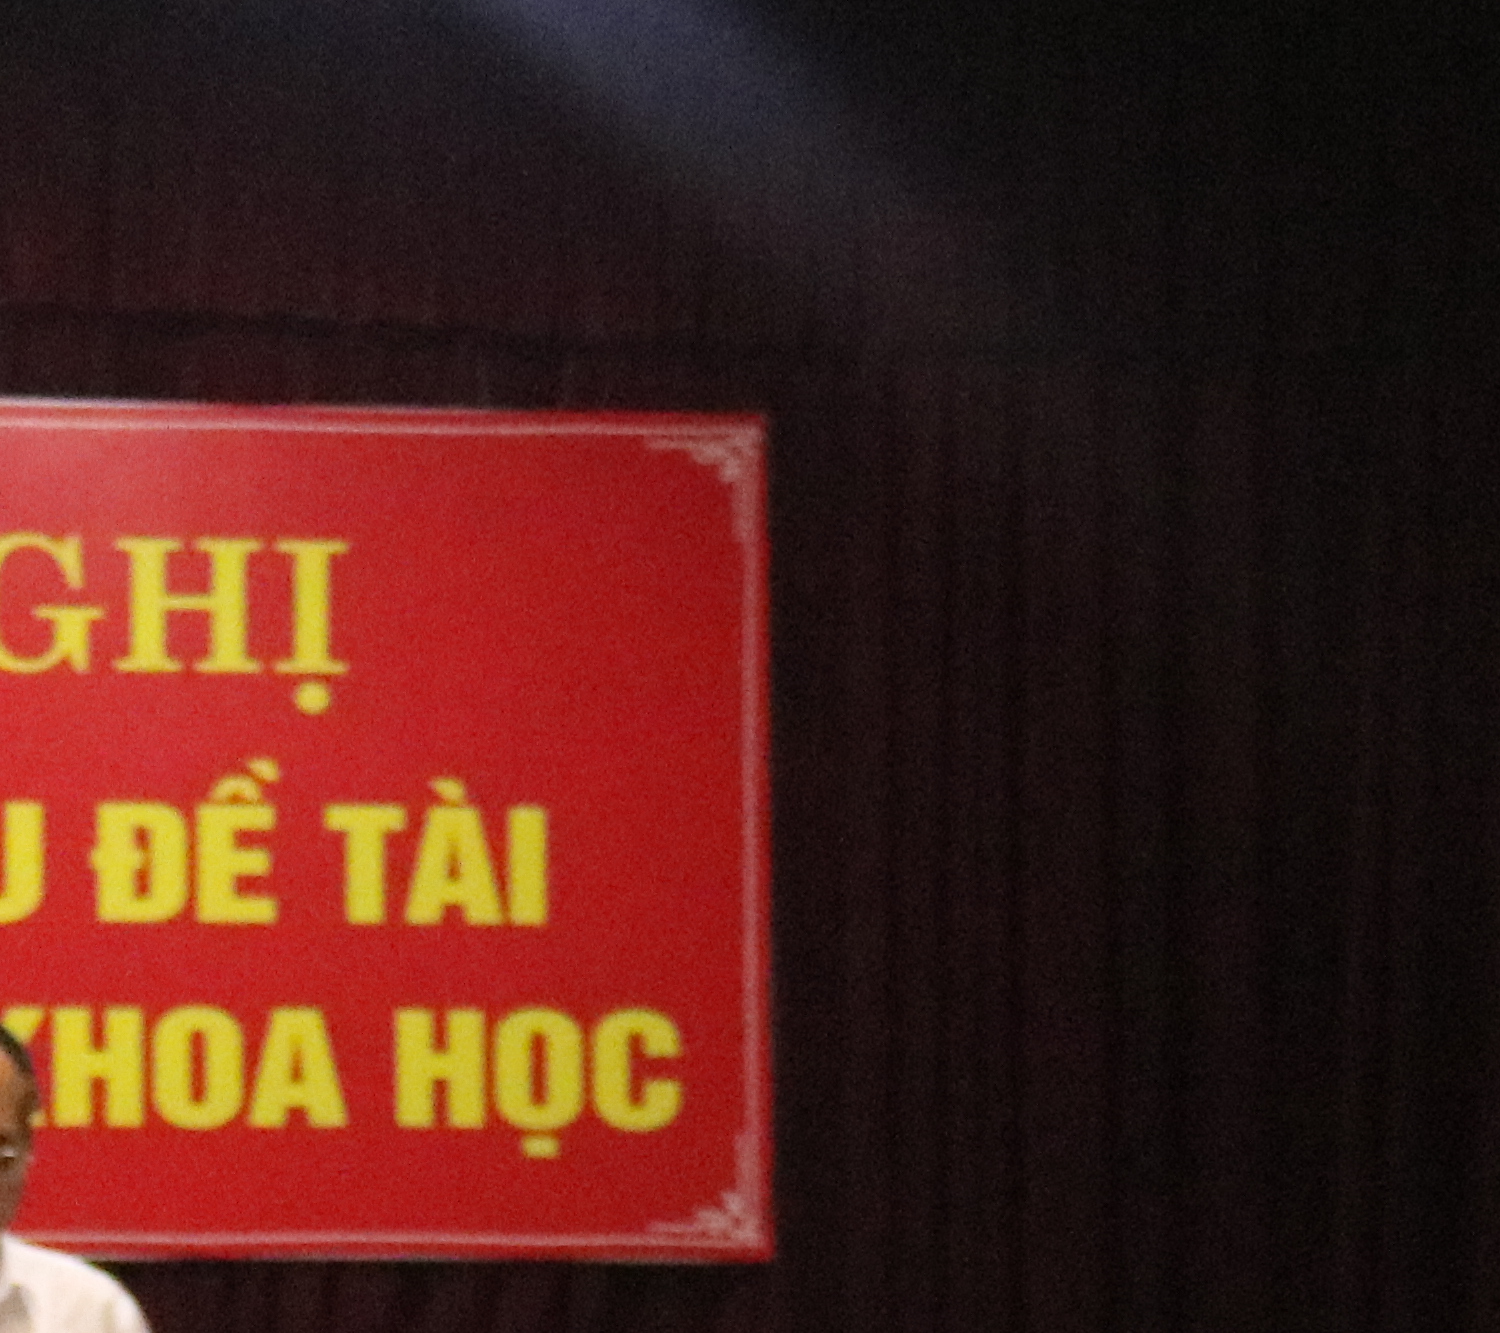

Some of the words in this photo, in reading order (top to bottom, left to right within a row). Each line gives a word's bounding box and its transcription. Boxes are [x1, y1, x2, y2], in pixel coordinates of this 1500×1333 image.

[90, 758, 280, 925] ĐỀ
[324, 778, 549, 927] TÀI
[395, 1007, 683, 1159] HỌC
